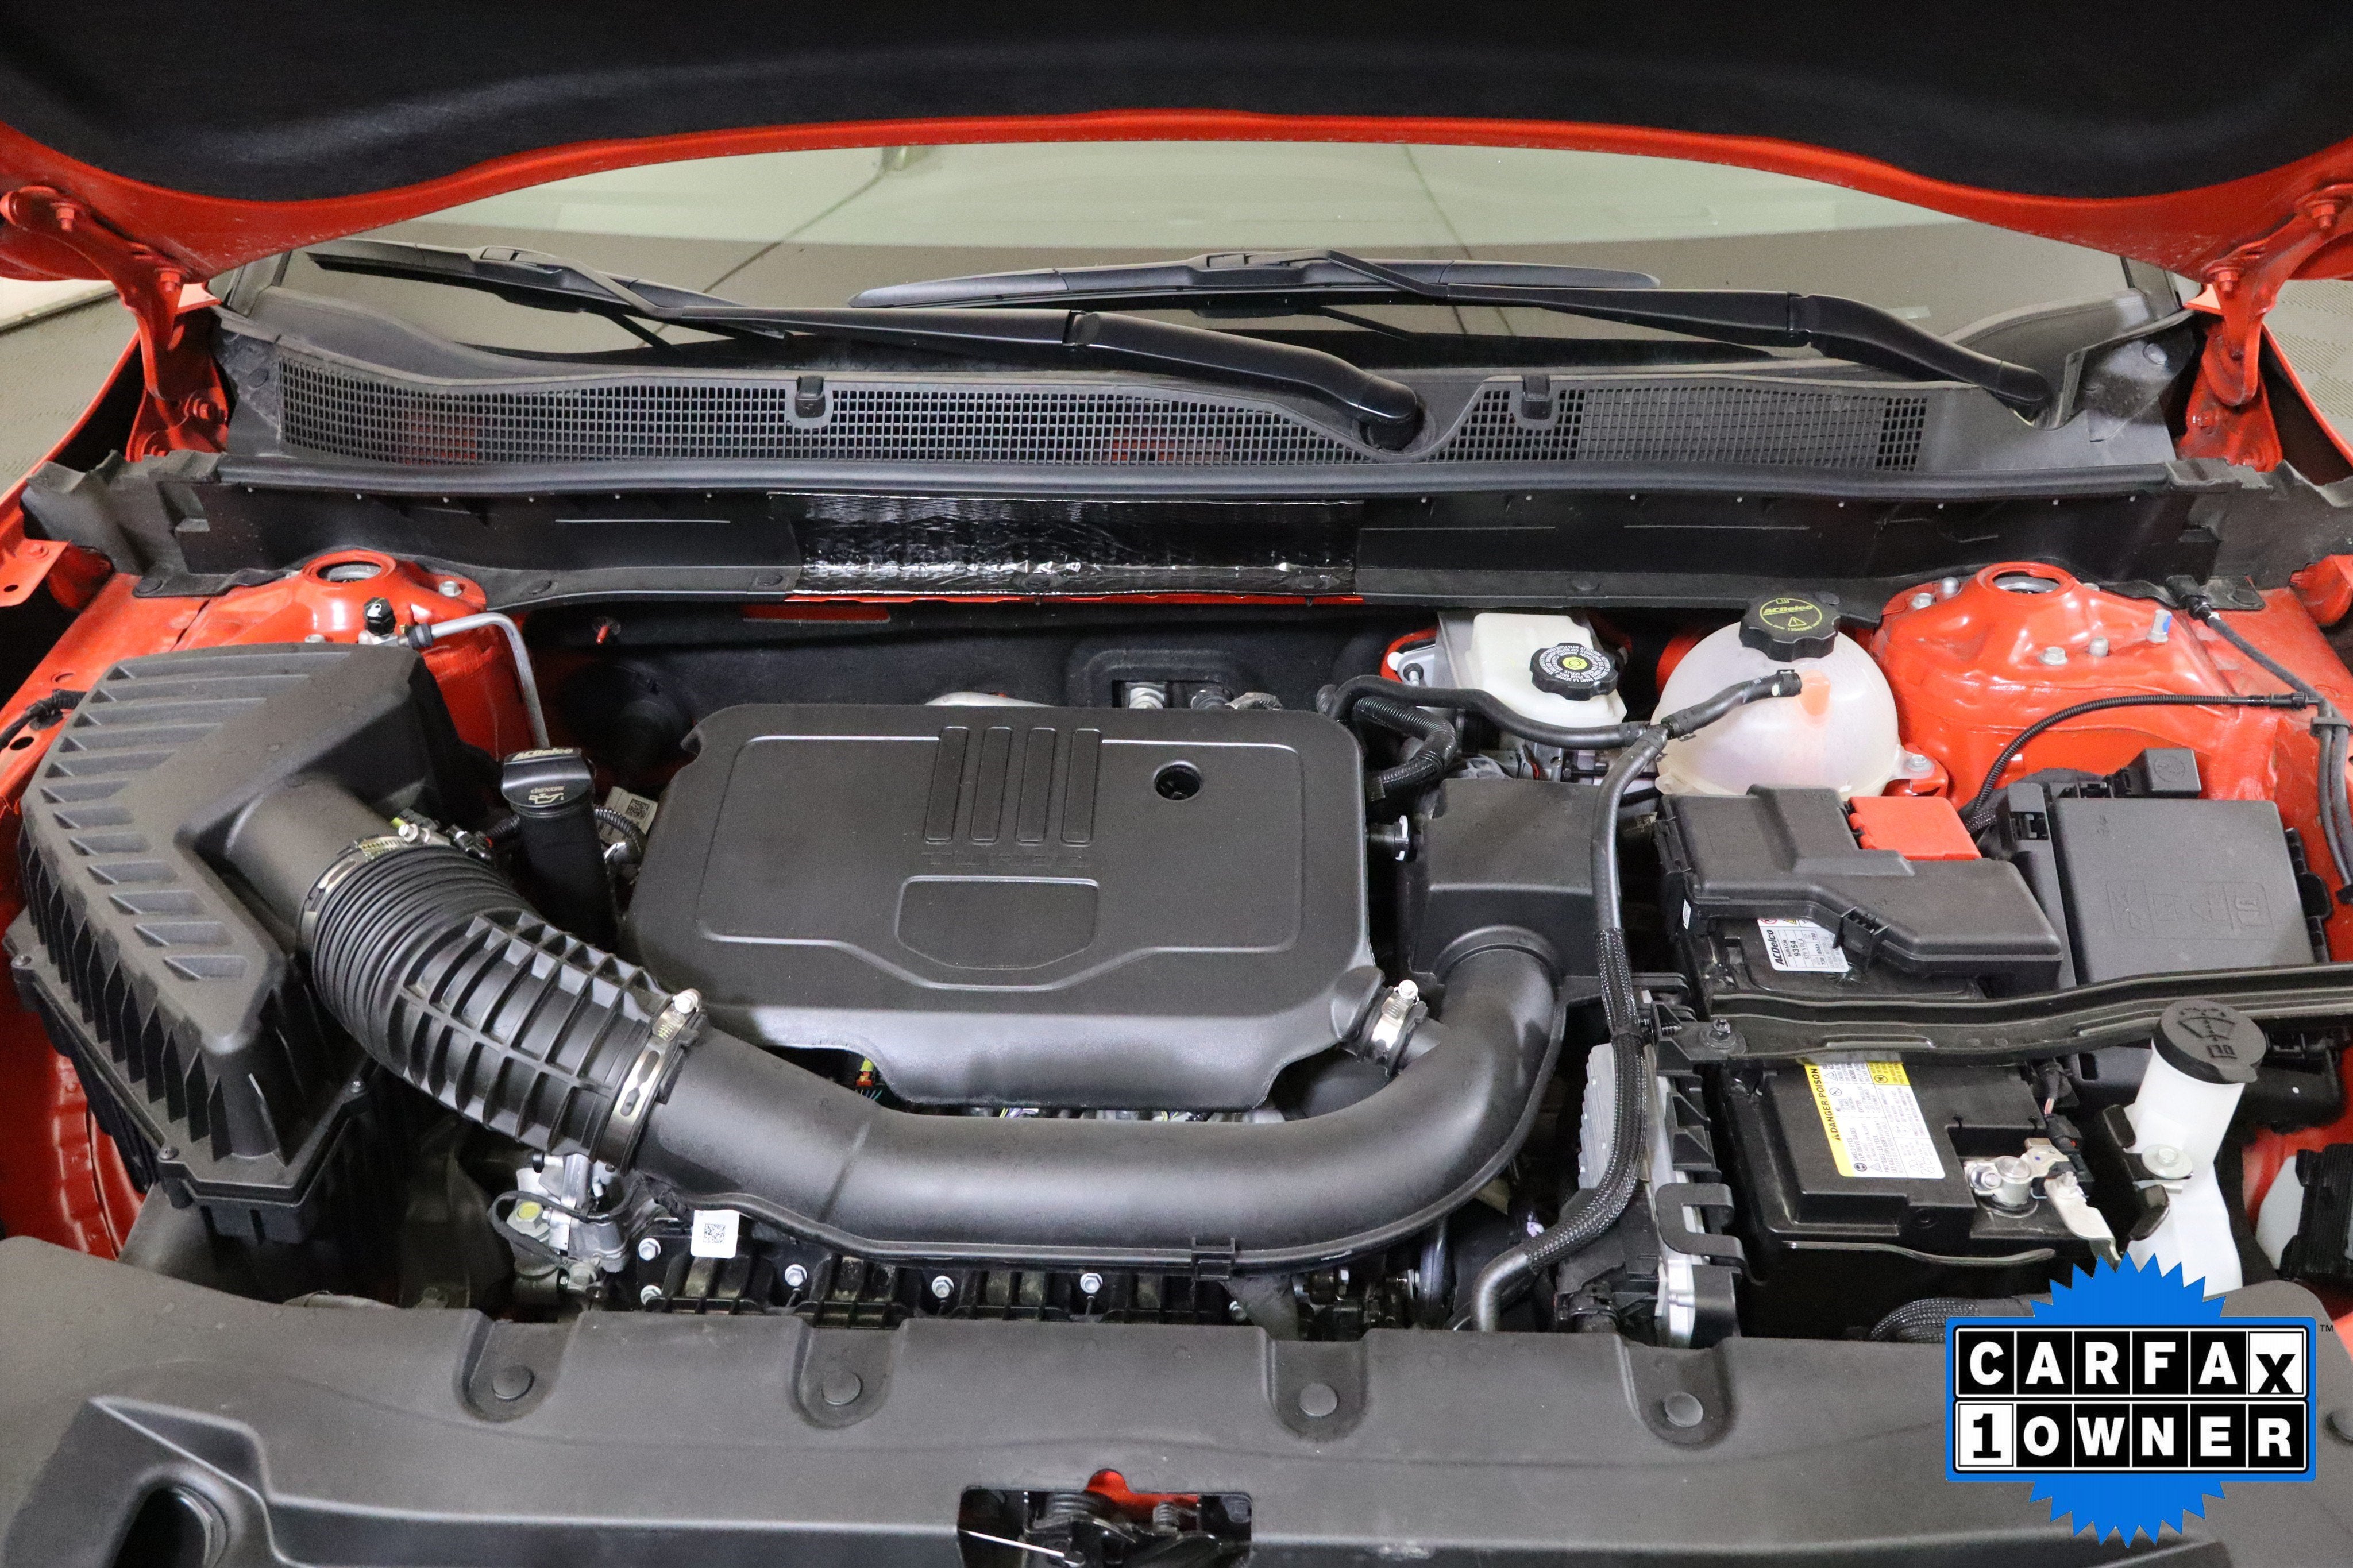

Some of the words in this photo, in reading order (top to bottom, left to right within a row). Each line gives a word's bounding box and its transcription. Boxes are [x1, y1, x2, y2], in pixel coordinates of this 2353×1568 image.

[1764, 605, 1813, 613] ACDelco
[511, 748, 573, 762] ACDelco
[1766, 929, 1784, 965] ACDelco
[1790, 940, 1801, 956] 9354
[1811, 1069, 1838, 1133] DANGER/POISON
